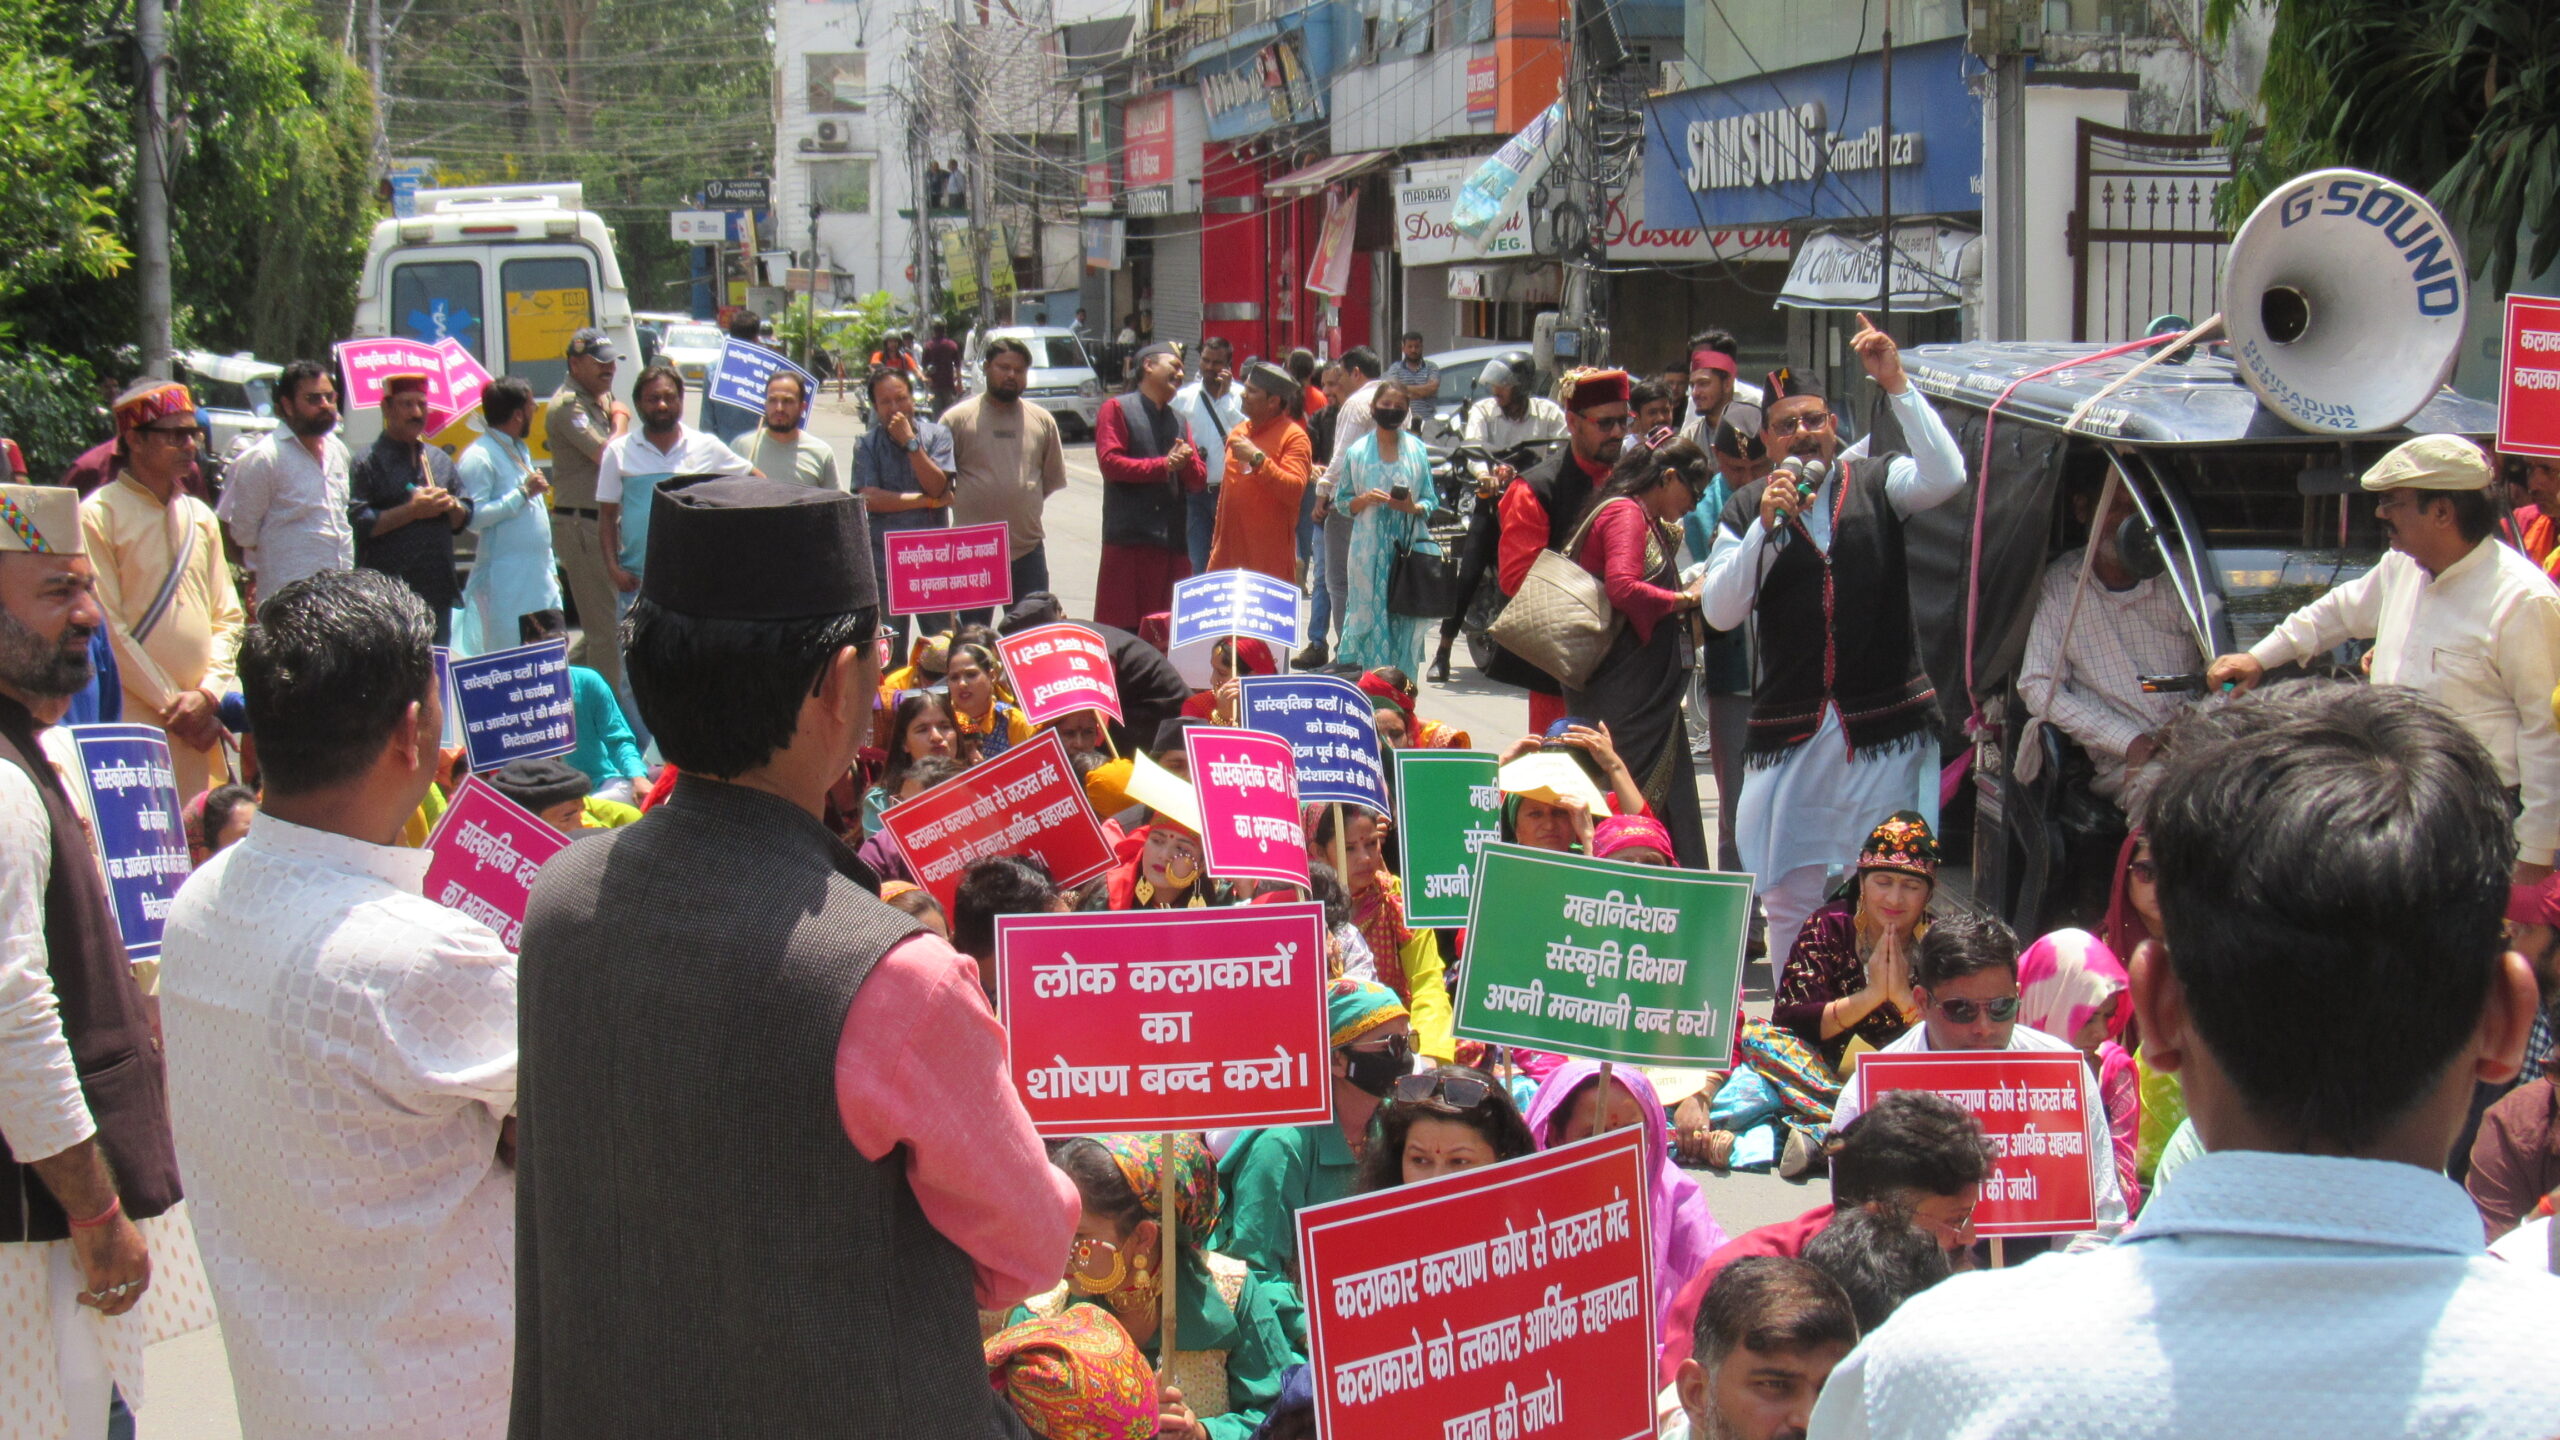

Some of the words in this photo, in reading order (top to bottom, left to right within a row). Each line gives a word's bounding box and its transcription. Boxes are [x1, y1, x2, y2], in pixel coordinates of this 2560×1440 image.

[1686, 102, 1820, 193] SAMSUNG
[1825, 124, 1916, 173] SmartPlza
[724, 189, 766, 199] PADUKA
[1402, 187, 1451, 204] MADRASI
[1404, 210, 1458, 241] Dos
[2248, 339, 2355, 417] DEHRADUN
[897, 544, 934, 569] सांस्कृतिक
[934, 543, 950, 563] दलों
[956, 542, 973, 561] लोक
[909, 579, 920, 592] का
[921, 576, 948, 599] भुगतान
[949, 574, 968, 590] समय
[462, 668, 512, 690] सांस्कृतिक
[514, 662, 533, 679] दलों
[509, 686, 523, 702] को
[1253, 693, 1313, 715] सांस्कृतिक
[1315, 695, 1338, 711] दलों
[468, 721, 484, 733] का
[1305, 718, 1323, 734] को
[1315, 742, 1333, 763] पूर्व
[1335, 743, 1350, 760] की
[91, 758, 138, 797] सांस्कृतिक
[1208, 753, 1265, 797] सांस्कृतिक
[1265, 760, 1286, 793] दलों
[1345, 768, 1355, 784] से
[904, 819, 947, 850] कलाकार
[942, 806, 977, 834] कल्याण
[973, 794, 997, 819] कोष
[993, 784, 1008, 810] से
[1038, 760, 1060, 786] मंद
[1005, 811, 1041, 845] आर्थिक
[1039, 795, 1080, 830] सहायता
[455, 819, 522, 874] सांस्कृतिक
[1233, 814, 1252, 838] का
[1252, 816, 1290, 853] भुगतान
[1424, 863, 1470, 898] अपनी
[1563, 889, 1680, 934] महानिदेशक
[1032, 951, 1119, 999] लोक
[1128, 941, 1298, 994] कलाकारों
[1546, 934, 1623, 988] संस्कृति
[1626, 943, 1687, 986] विभाग
[1483, 978, 1545, 1017] अपनी
[1547, 992, 1632, 1032] मनमानी
[1634, 1005, 1674, 1034] बन्द
[1676, 1000, 1718, 1038] करो।
[1139, 1011, 1193, 1043] का
[1026, 1054, 1131, 1099] शोषण
[1139, 1061, 1214, 1096] बन्द
[1222, 1044, 1308, 1092] करो।
[1988, 1080, 2014, 1112] कोष
[2016, 1080, 2028, 1112] से
[2060, 1080, 2078, 1111] मंद
[2010, 1122, 2046, 1157] आर्थिक
[2047, 1131, 2083, 1158] सहायता
[1985, 1168, 2004, 1202] की
[1332, 1259, 1418, 1320] कलाकार
[1420, 1241, 1488, 1298] कल्याण
[1490, 1217, 1528, 1278] कोष
[1531, 1208, 1548, 1269] से
[1604, 1185, 1629, 1244] मंद
[1426, 1318, 1455, 1380] को
[1524, 1282, 1578, 1354] आर्थिक
[1581, 1276, 1639, 1334] सहायता
[1495, 1381, 1519, 1440] की
